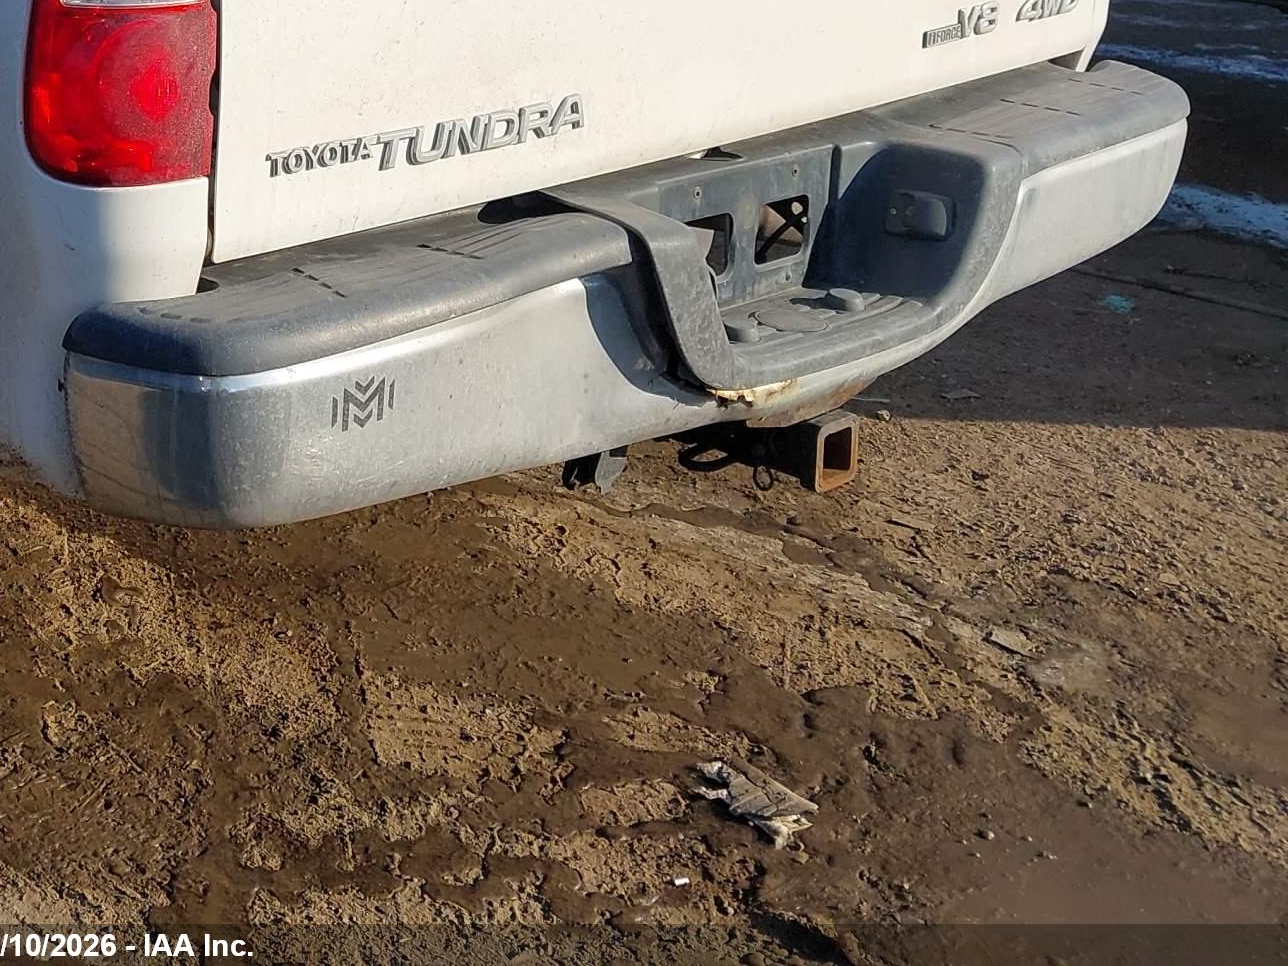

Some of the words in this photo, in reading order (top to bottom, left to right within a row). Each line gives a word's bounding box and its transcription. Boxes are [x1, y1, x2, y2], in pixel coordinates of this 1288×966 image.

[958, 0, 1000, 39] V8
[265, 137, 375, 178] TOYOTA
[373, 93, 585, 172] TUNDRA
